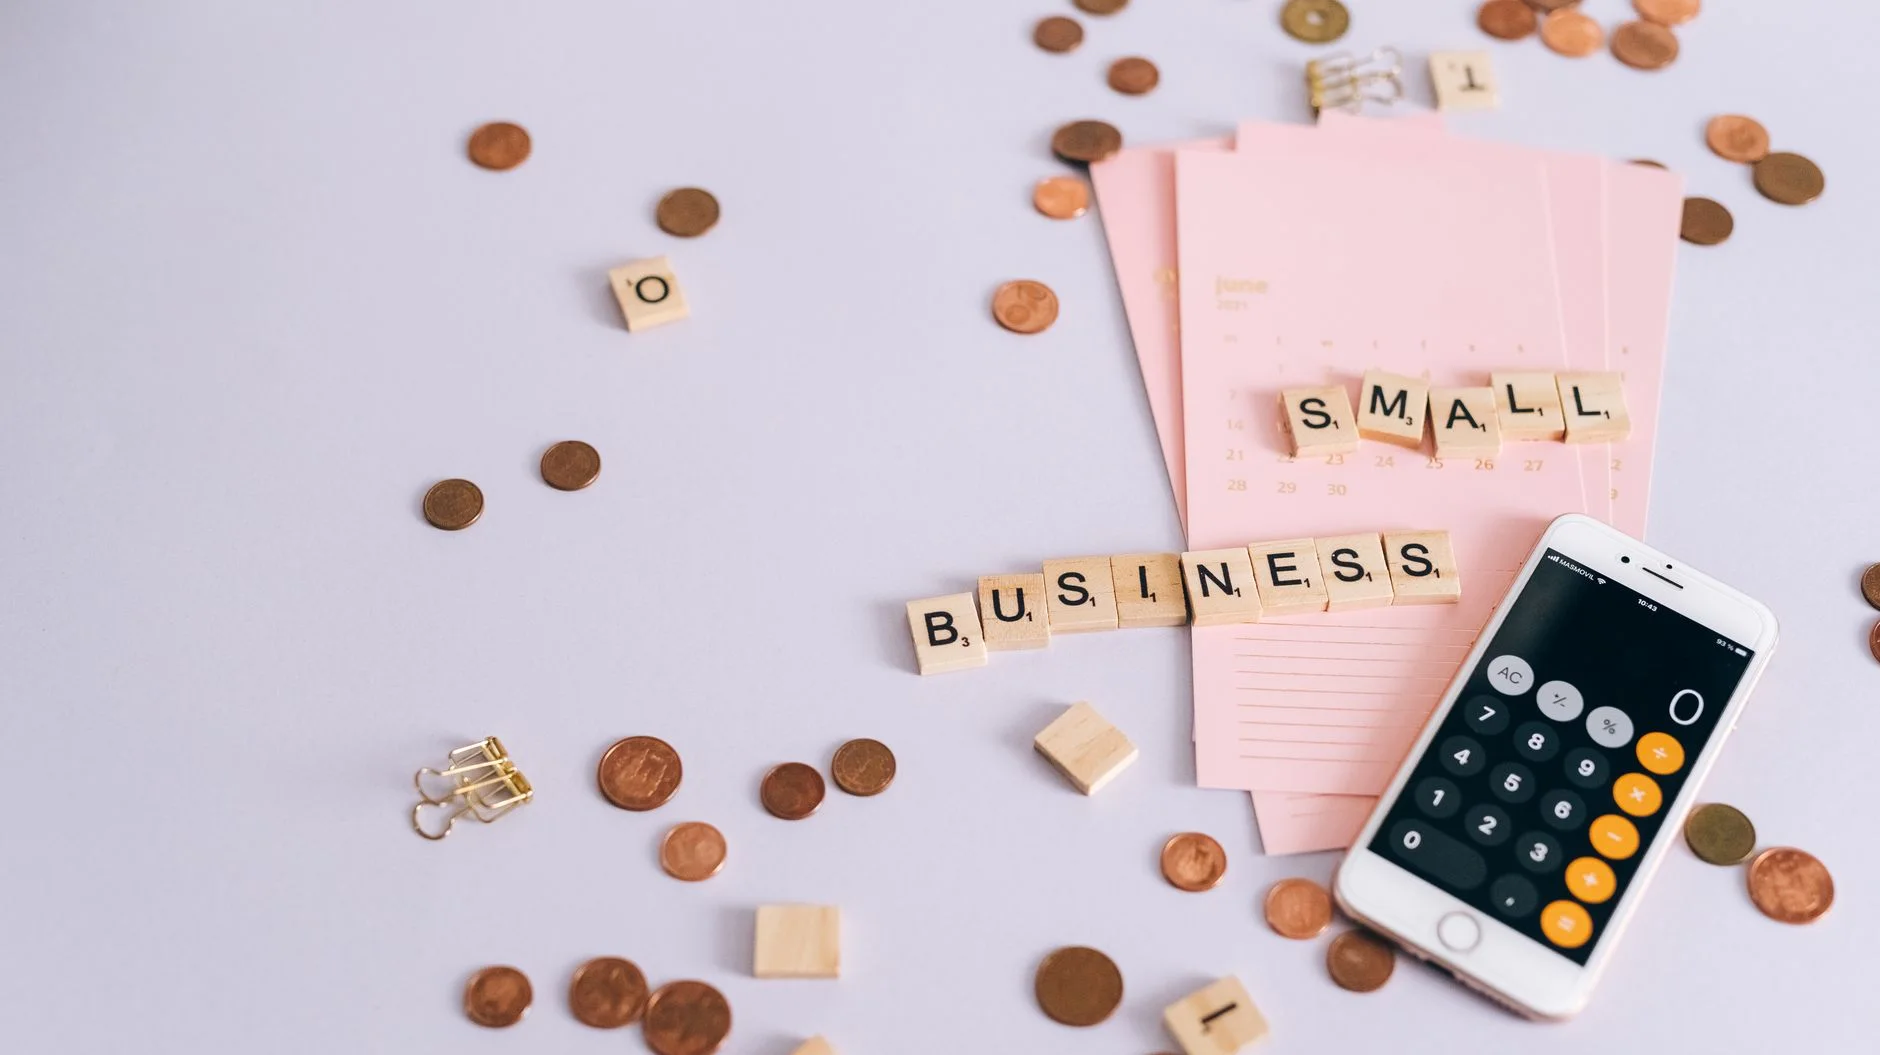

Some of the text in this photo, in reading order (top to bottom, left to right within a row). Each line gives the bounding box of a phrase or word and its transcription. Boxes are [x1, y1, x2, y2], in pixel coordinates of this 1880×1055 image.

[1226, 449, 1244, 461] 21
[1375, 455, 1394, 468] 24
[1475, 458, 1493, 470] 26
[1524, 460, 1544, 472] 27
[1227, 479, 1346, 496] 28 29 30
[924, 543, 1433, 647] BUSINESS
[1637, 598, 1658, 612] 10:43
[1497, 667, 1523, 684] AC
[1478, 706, 1496, 721] 7
[1528, 733, 1545, 750] 8
[1454, 749, 1470, 765] 4
[1578, 758, 1595, 777] 9
[1504, 773, 1522, 792] 5
[1433, 789, 1445, 806] 1
[1554, 801, 1572, 819] 6
[1478, 815, 1497, 835] 2
[1403, 830, 1421, 849] 0
[1529, 843, 1548, 862] 3
